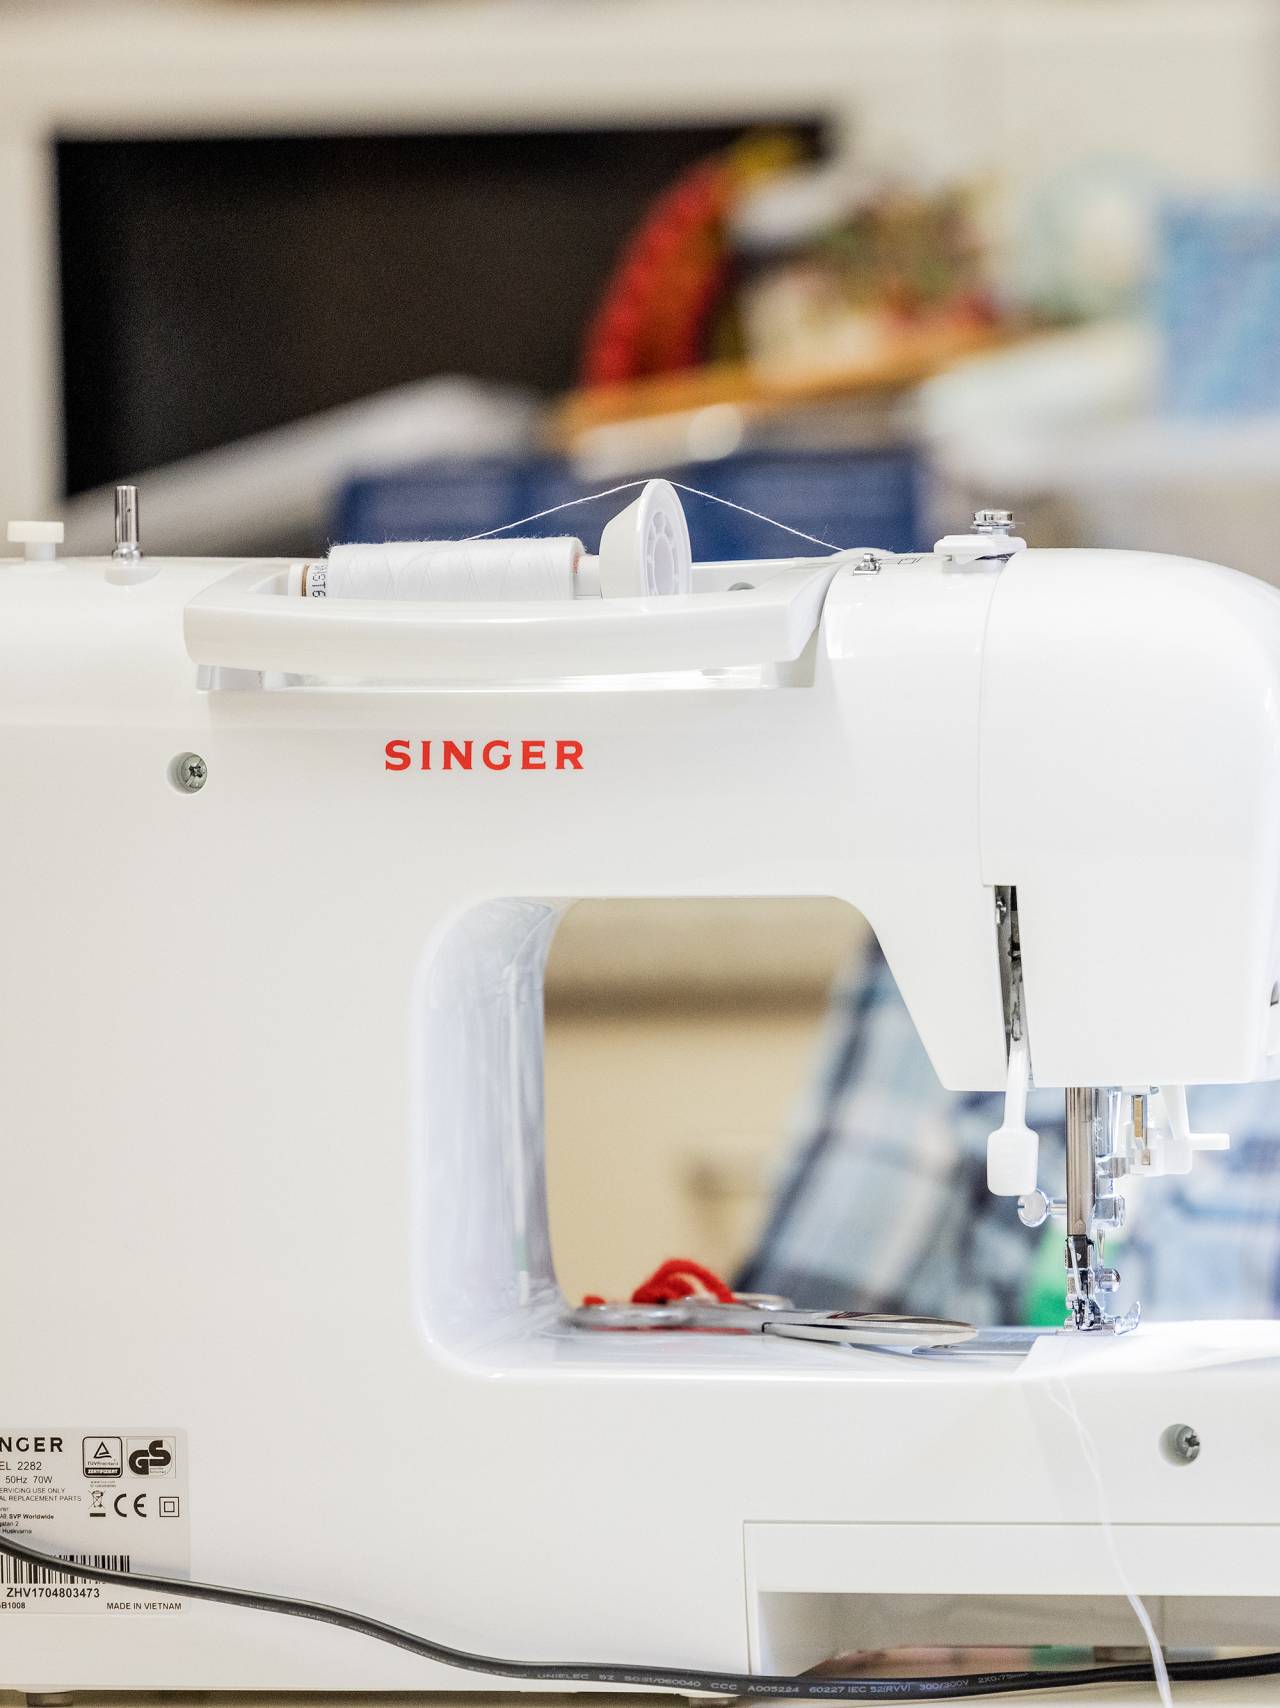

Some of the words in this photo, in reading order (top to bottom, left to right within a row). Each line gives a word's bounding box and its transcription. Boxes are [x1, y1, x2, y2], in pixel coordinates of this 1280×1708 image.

[385, 739, 585, 771] SINGER
[17, 1461, 42, 1471] 2282
[5, 1476, 28, 1484] 50Hz
[33, 1476, 53, 1484] 70W
[114, 1493, 147, 1518] CE
[6, 1587, 100, 1598] ZHV1704803473
[106, 1602, 131, 1610] MADE
[133, 1602, 142, 1610] IN
[144, 1602, 182, 1610] VIETNAM
[537, 1673, 589, 1681] UNIELEC
[710, 1682, 738, 1691] CCC
[747, 1685, 800, 1693] A005224
[809, 1685, 845, 1693] 60227
[847, 1685, 866, 1693] IEC
[919, 1679, 970, 1691] 300/300V
